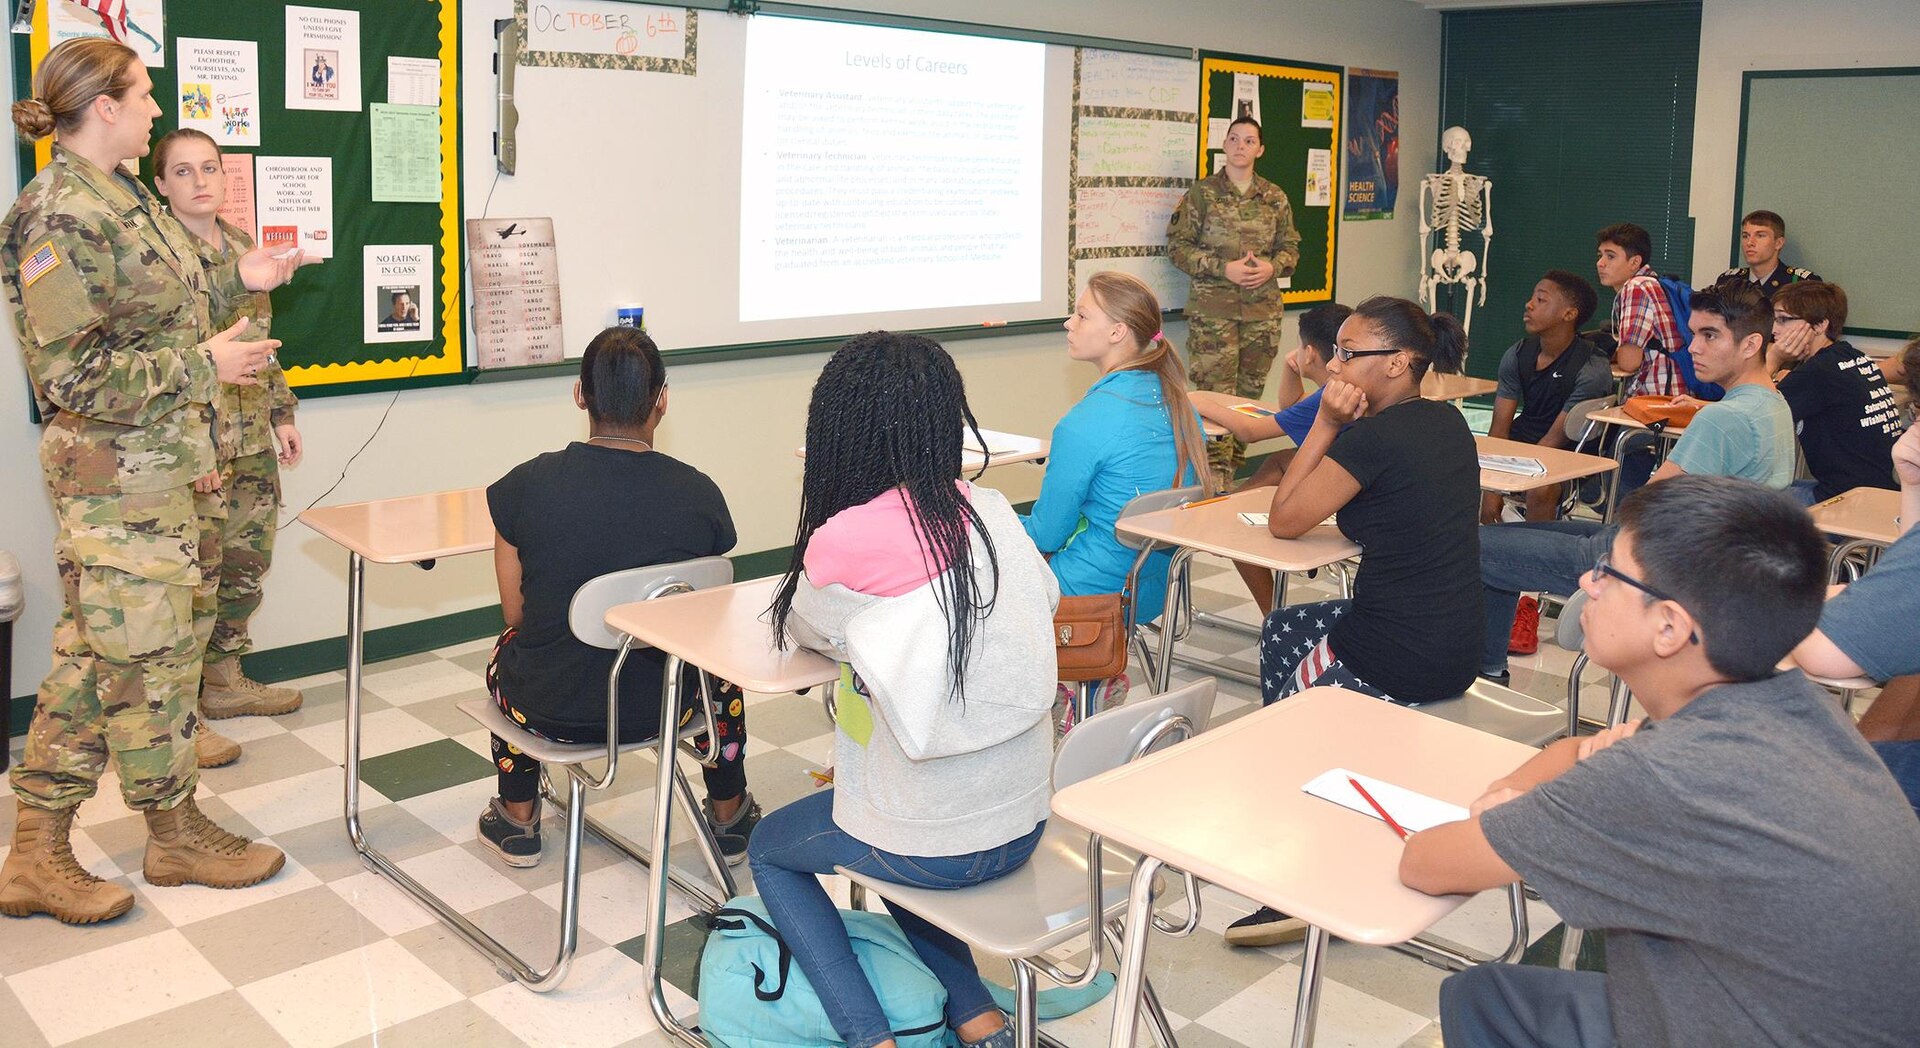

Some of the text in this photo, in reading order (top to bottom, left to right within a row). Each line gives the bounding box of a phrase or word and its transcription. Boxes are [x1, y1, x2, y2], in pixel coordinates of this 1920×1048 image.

[198, 57, 237, 65] EACHOTHER,
[845, 50, 969, 75] Levels of Careers
[190, 65, 230, 73] YOURSELVES,
[776, 151, 822, 161] Veterinary
[227, 166, 242, 174] 2016
[1349, 181, 1375, 192] HEALTH
[1348, 192, 1375, 203] SCIENCE
[233, 206, 248, 214] 2017
[266, 232, 294, 241] NETFLIX
[775, 236, 829, 246] Veterinarian
[376, 255, 421, 263] NO EATING
[381, 266, 416, 274] IN CLASS
[1860, 412, 1888, 428] Wishing
